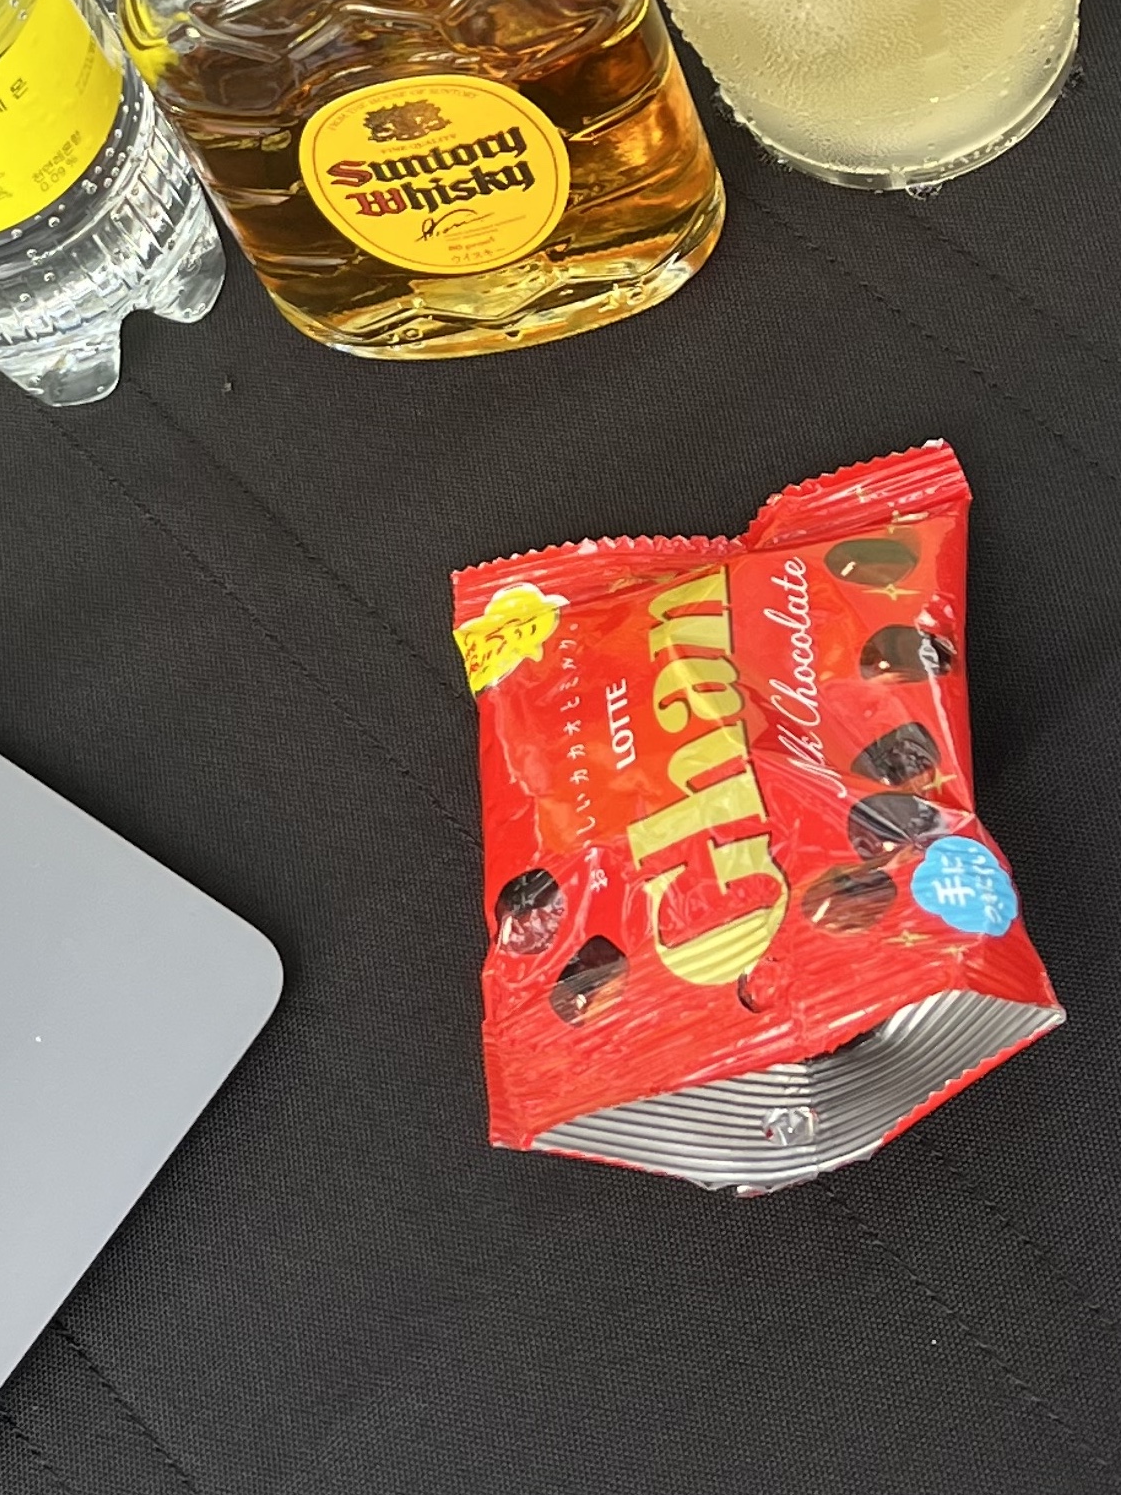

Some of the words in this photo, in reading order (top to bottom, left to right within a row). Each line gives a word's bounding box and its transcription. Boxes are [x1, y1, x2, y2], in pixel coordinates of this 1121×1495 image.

[326, 126, 527, 187] Suntory
[345, 160, 536, 216] Whisky
[763, 556, 821, 727] Chocolate
[606, 677, 637, 770] LOTTE
[930, 855, 976, 908] 手に
